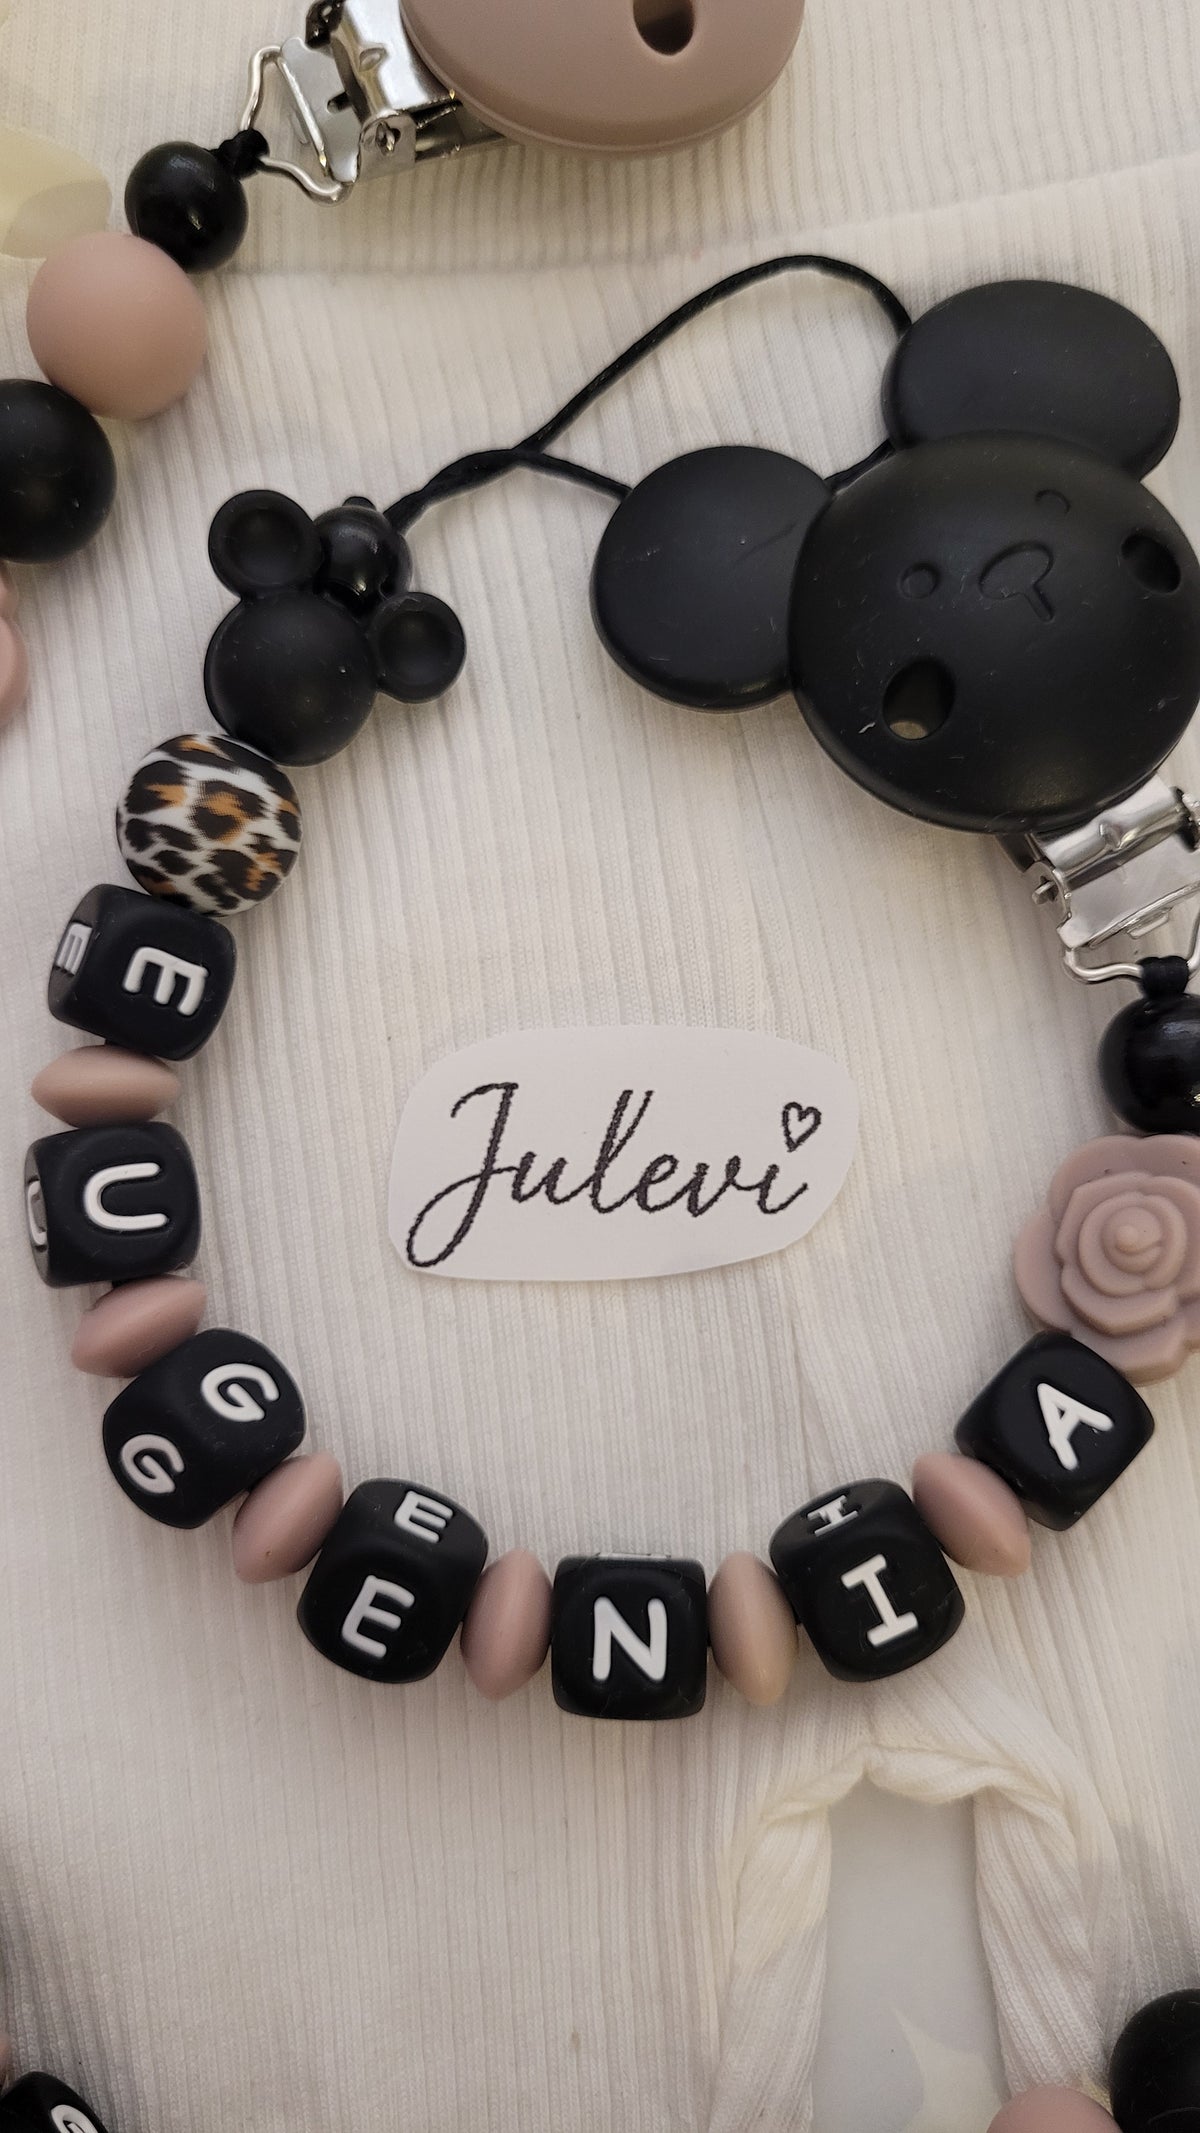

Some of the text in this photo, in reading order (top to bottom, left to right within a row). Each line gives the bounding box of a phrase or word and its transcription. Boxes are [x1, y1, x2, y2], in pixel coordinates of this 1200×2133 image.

[125, 946, 207, 1015] E
[84, 1162, 168, 1231] U
[406, 1081, 822, 1268] Julevi
[202, 1363, 279, 1422] G
[1037, 1383, 1114, 1470] A
[121, 1434, 185, 1494] G
[394, 1490, 453, 1543] E
[342, 1575, 415, 1657] E
[842, 1554, 918, 1647] I
[592, 1598, 668, 1681] N
